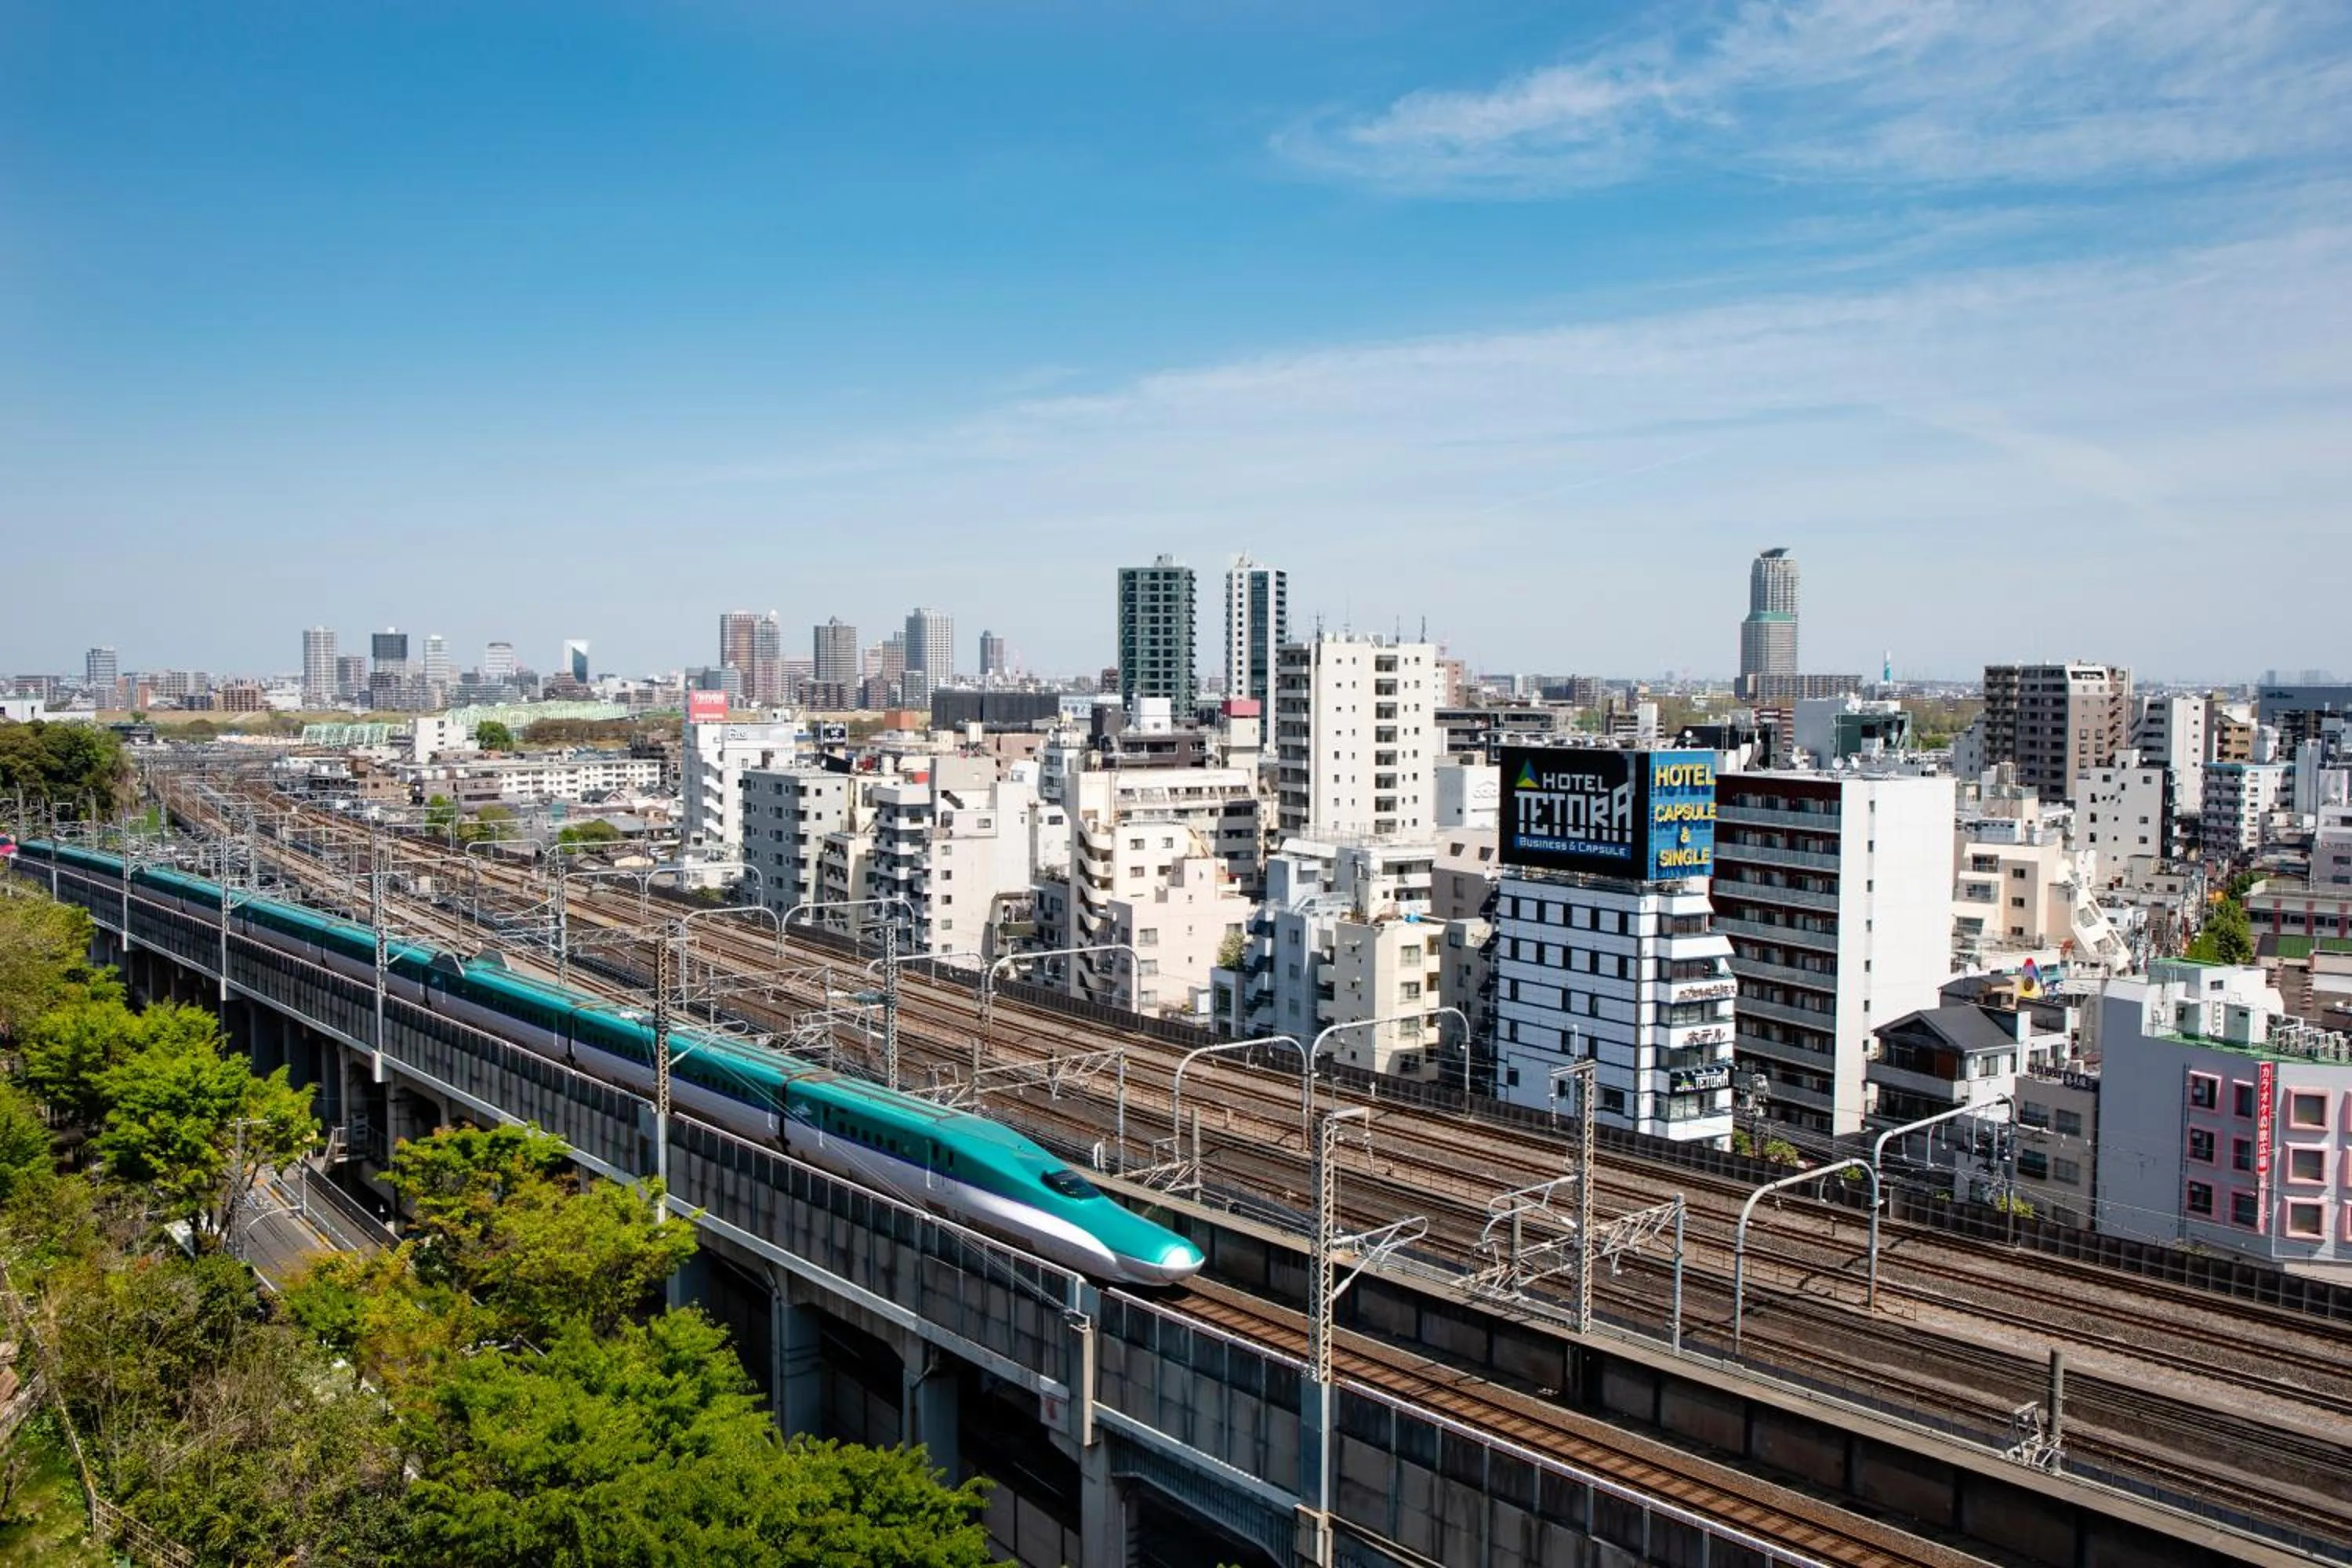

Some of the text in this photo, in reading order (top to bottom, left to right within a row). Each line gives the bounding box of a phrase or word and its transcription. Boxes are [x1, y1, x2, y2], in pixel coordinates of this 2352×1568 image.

[1542, 771, 1610, 793] HOTEL
[1655, 764, 1717, 787] HOTEL
[1514, 781, 1633, 844] TETORA
[1655, 802, 1719, 822] CAPSULE
[1679, 826, 1691, 843] &
[1569, 840, 1577, 851] &
[1659, 847, 1712, 867] SINGLE
